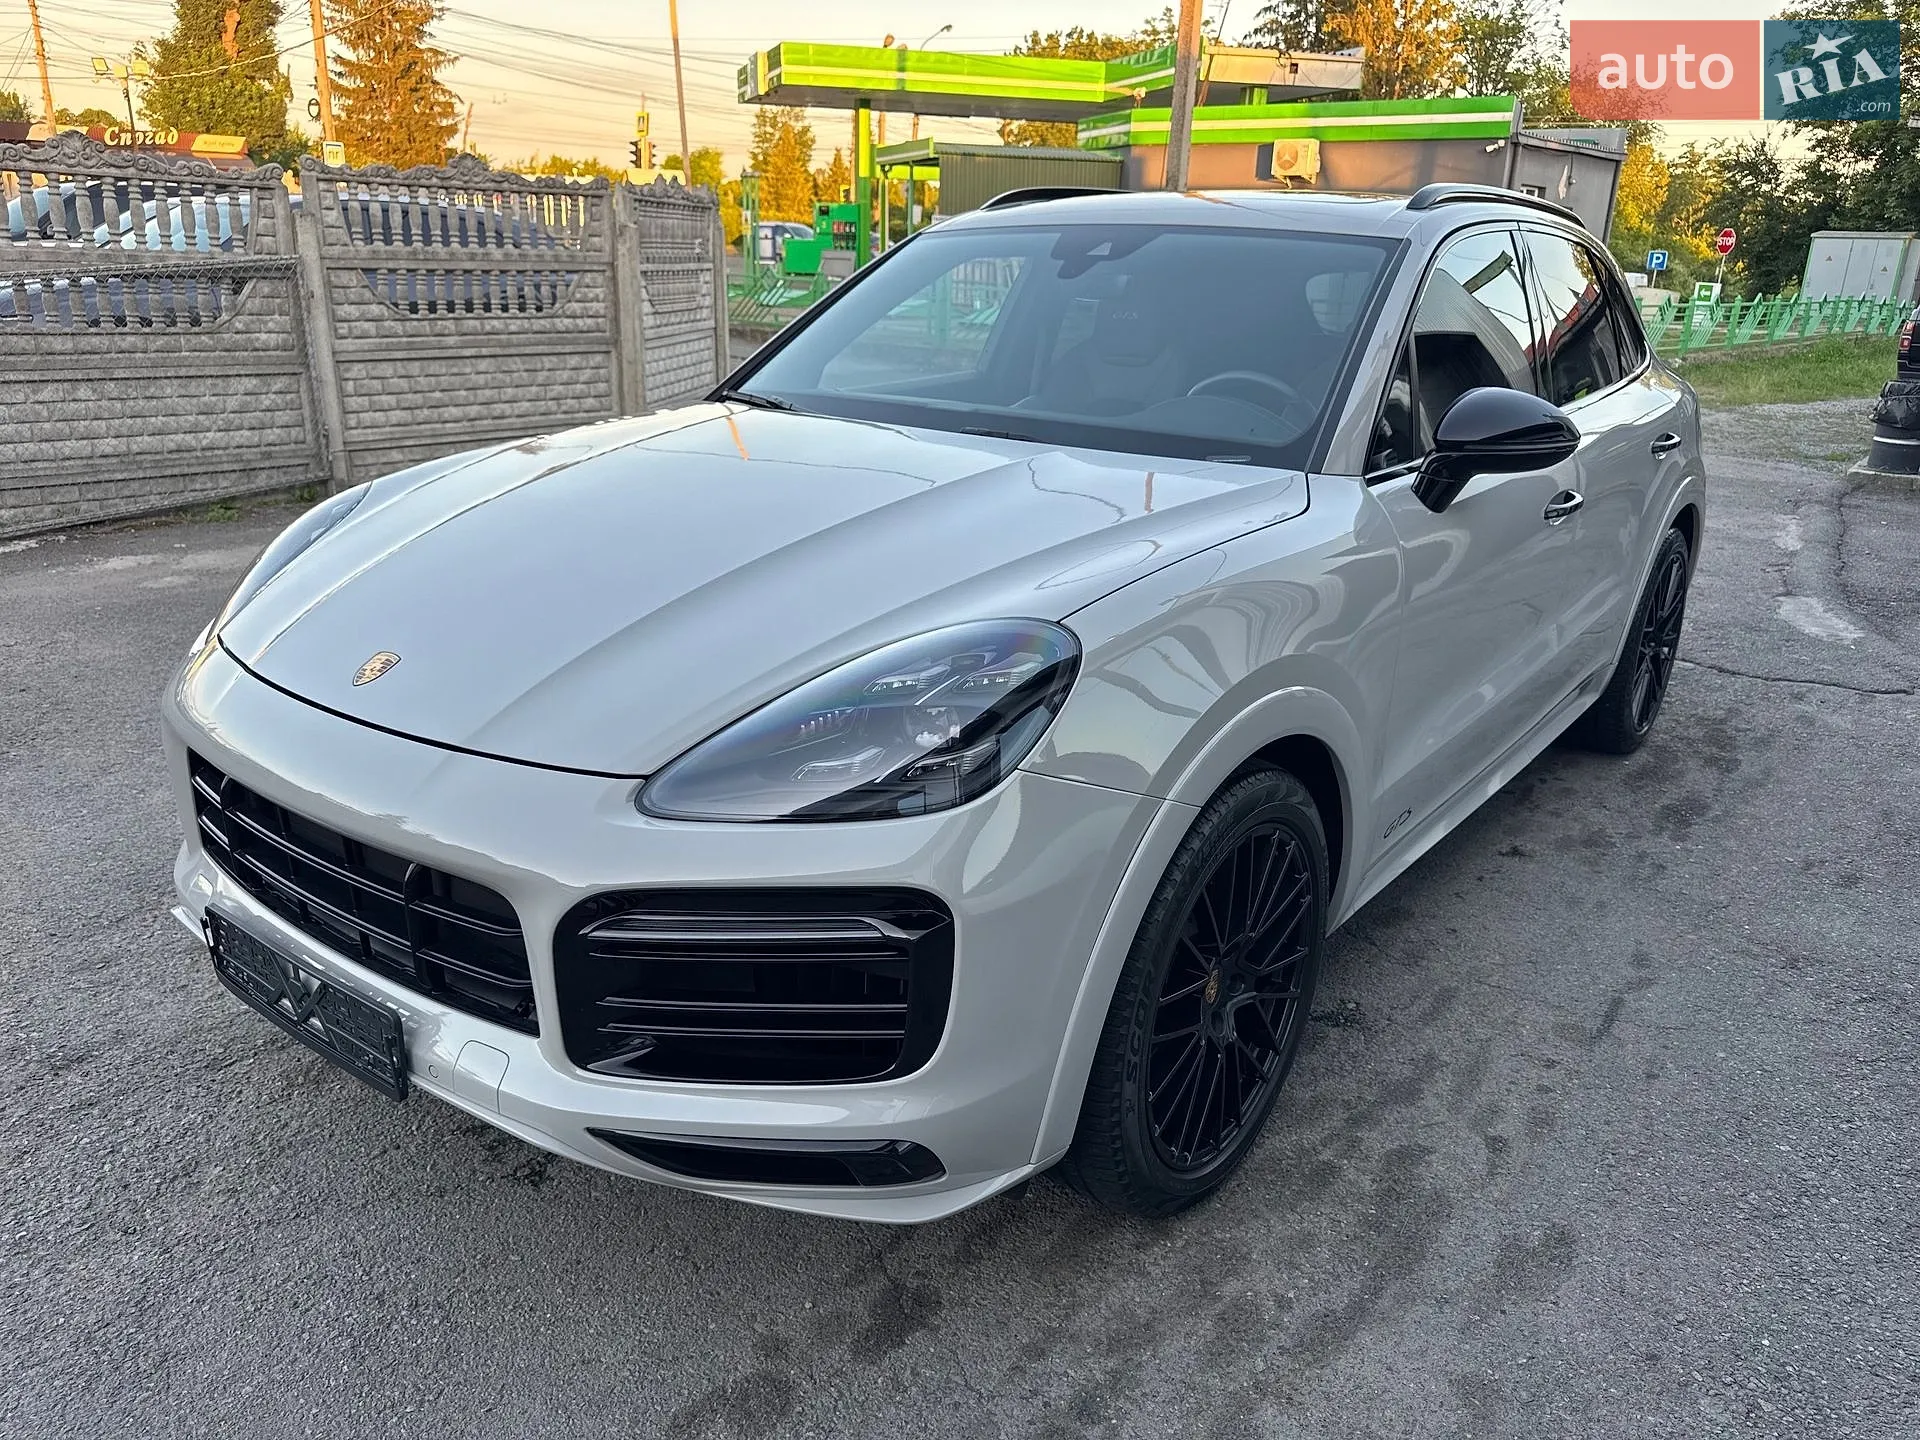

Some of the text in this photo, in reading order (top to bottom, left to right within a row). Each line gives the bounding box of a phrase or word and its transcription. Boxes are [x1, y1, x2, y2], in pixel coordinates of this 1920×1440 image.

[104, 126, 179, 146] Спогад
[1718, 237, 1735, 246] STOP
[1651, 253, 1664, 268] P
